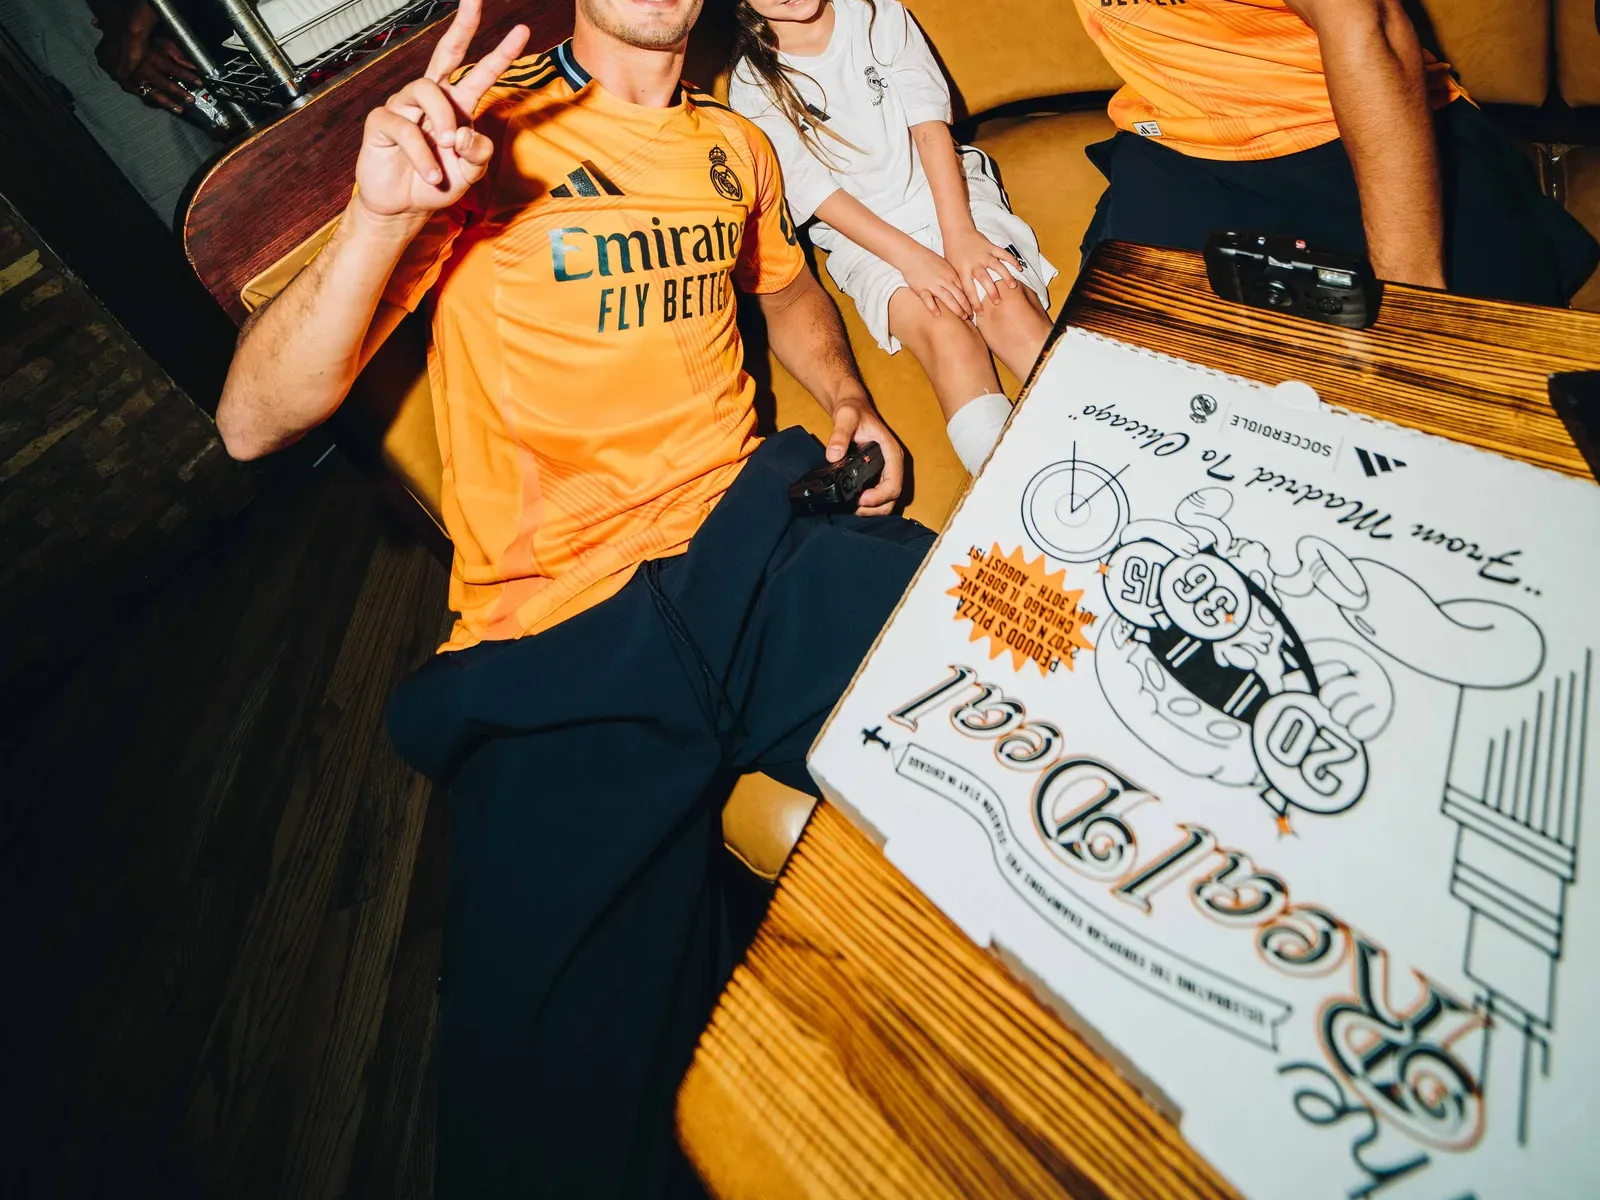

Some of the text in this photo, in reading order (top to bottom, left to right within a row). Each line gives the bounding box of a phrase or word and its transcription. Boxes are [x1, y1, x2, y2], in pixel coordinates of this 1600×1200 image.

[598, 282, 650, 333] FLY
[1230, 414, 1333, 458] SOCCERBIBLE
[1201, 448, 1235, 482] To
[1245, 466, 1392, 541] Madrid
[975, 568, 1008, 594] 60614
[1010, 587, 1020, 601] IL
[1121, 556, 1164, 608] 15
[1172, 564, 1238, 626] 36
[956, 595, 996, 631] PIZZA
[980, 590, 1037, 632] CLYBOURN
[1036, 625, 1046, 640] N
[1048, 633, 1081, 660] 2207
[1266, 705, 1358, 796] 20
[887, 664, 1495, 1153] Real Deal
[1277, 1062, 1478, 1200] he
